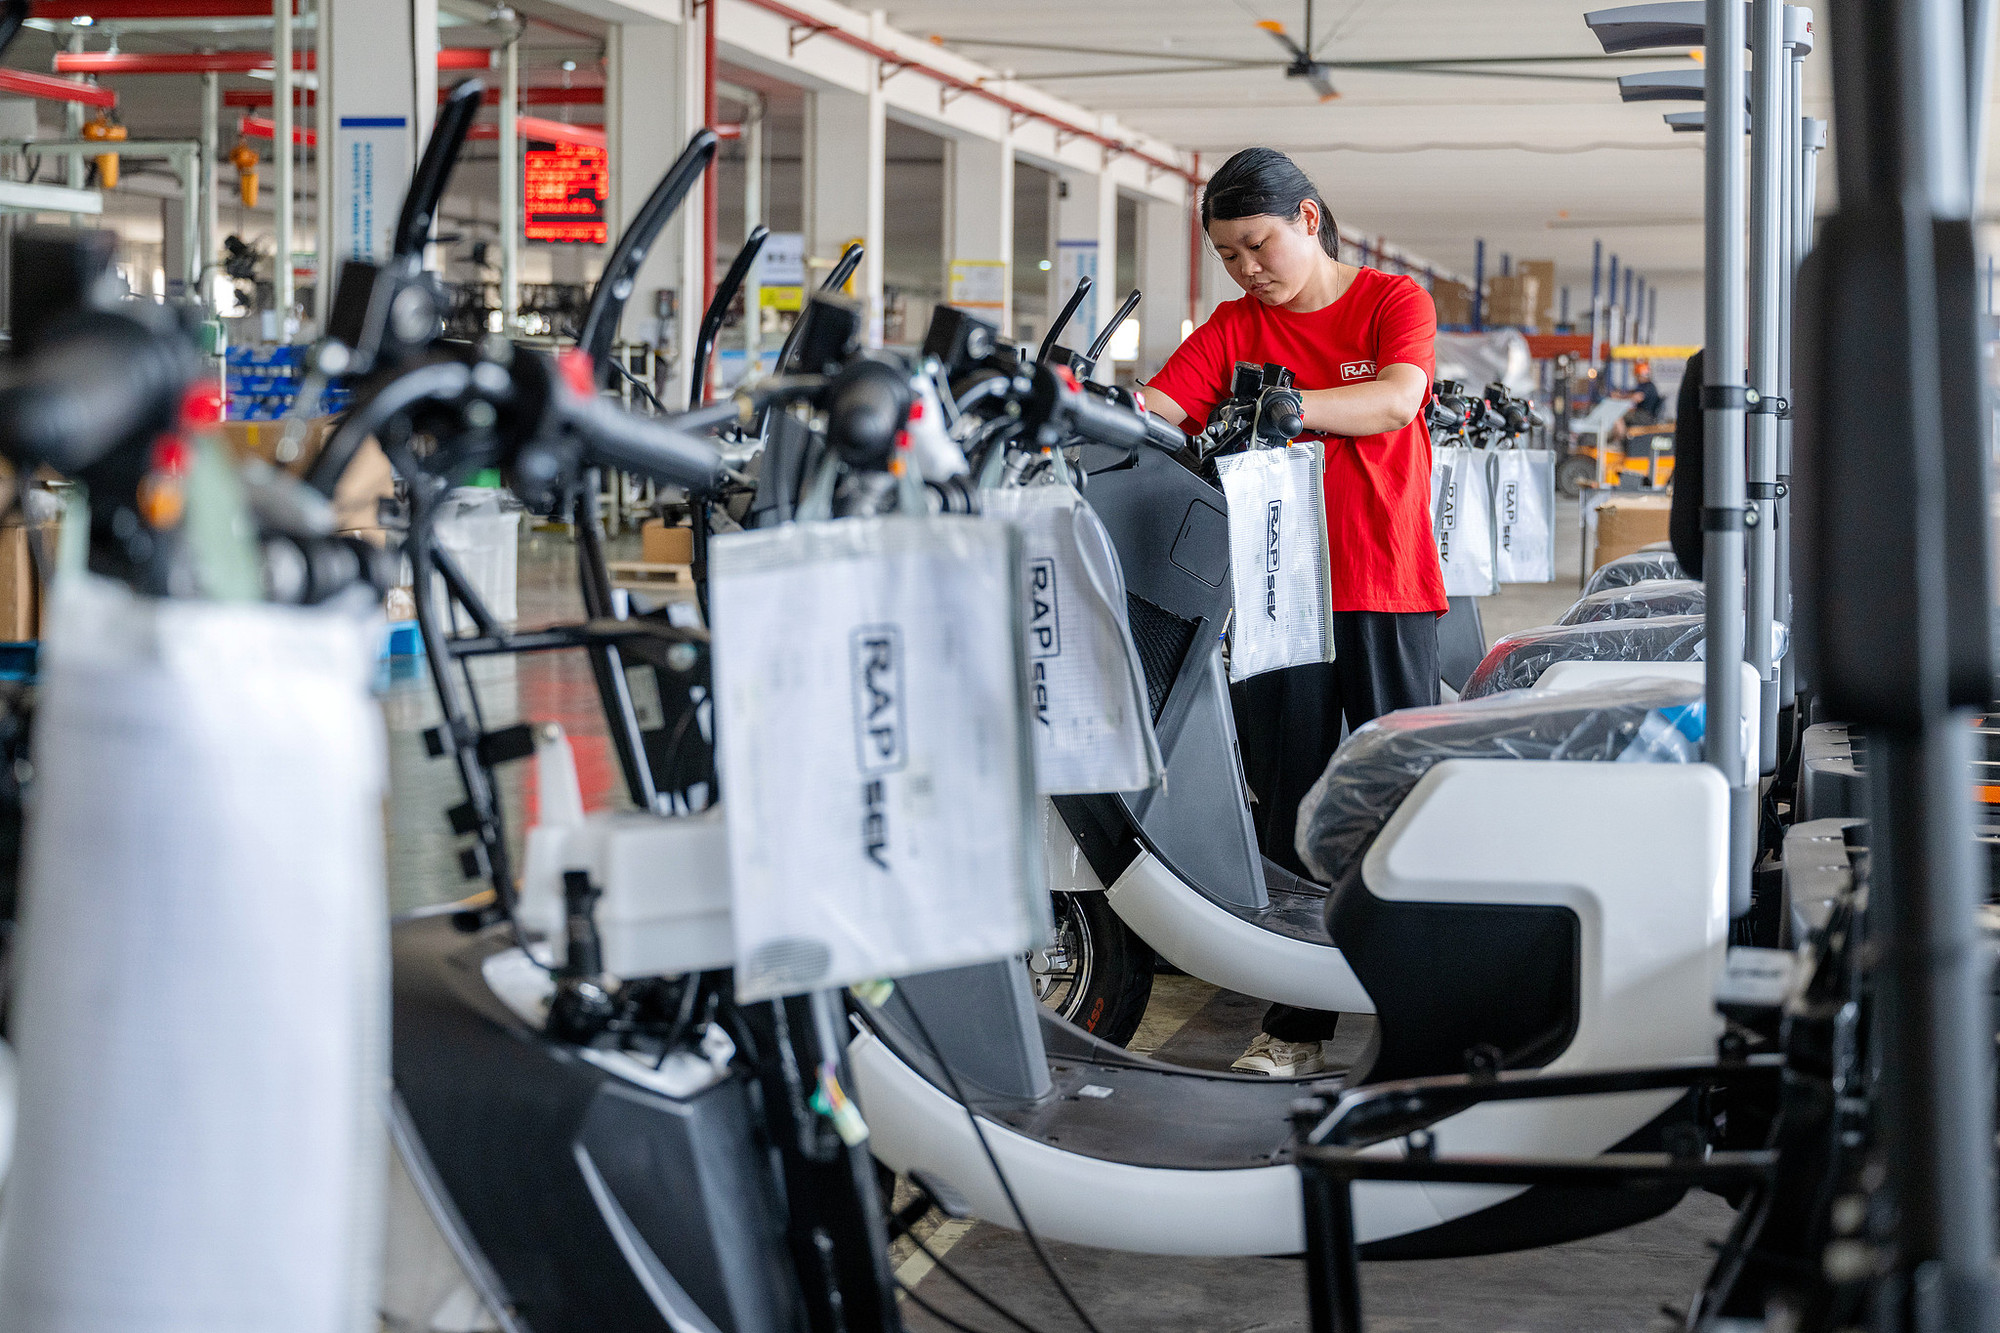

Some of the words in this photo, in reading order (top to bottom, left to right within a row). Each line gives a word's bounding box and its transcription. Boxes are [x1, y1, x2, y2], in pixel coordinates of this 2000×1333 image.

[1268, 505, 1280, 567] RAP
[1505, 484, 1516, 520] RAP
[1031, 564, 1053, 649] RAP
[864, 636, 897, 760] RAP
